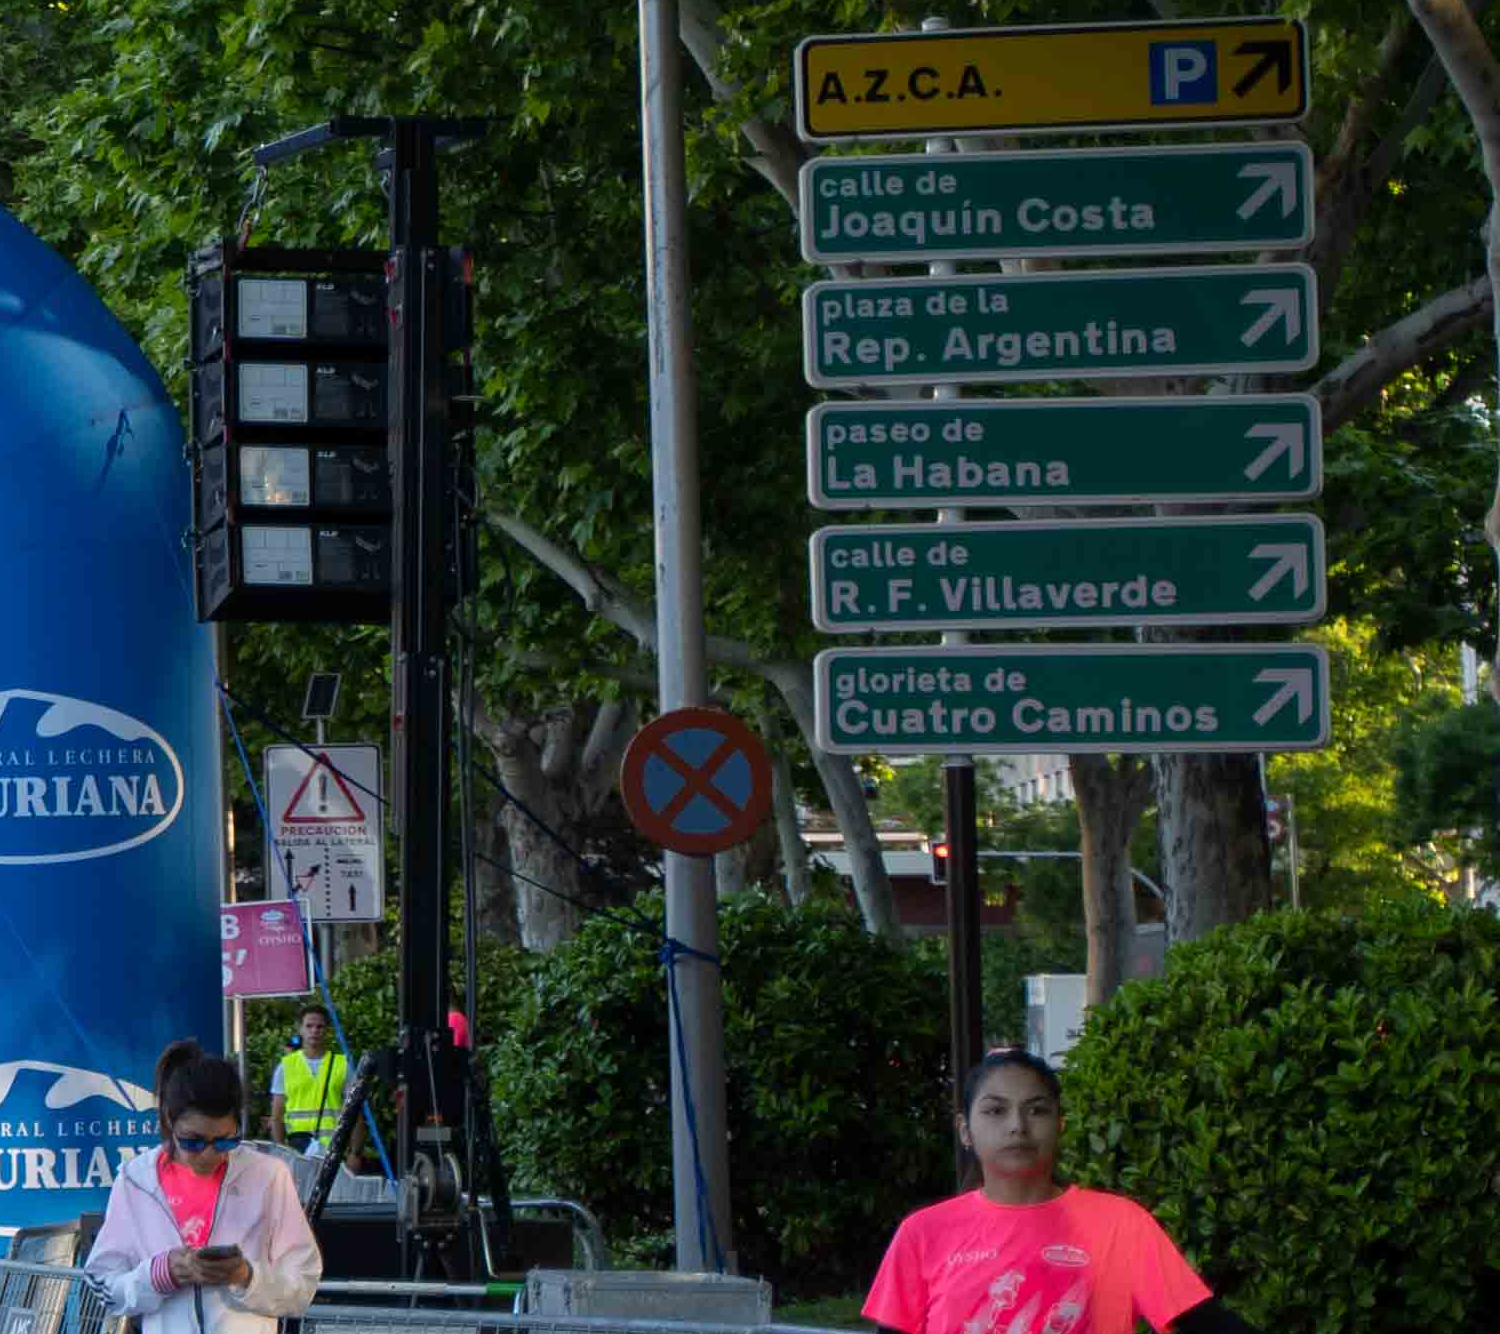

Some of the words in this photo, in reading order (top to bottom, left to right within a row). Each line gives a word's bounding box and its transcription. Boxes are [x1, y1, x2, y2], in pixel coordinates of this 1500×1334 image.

[816, 65, 1003, 106] A.Z.C.A.
[1163, 47, 1209, 99] P
[819, 170, 908, 199] calle
[916, 169, 958, 197] de
[820, 197, 1003, 243] Joaquín
[1017, 193, 1156, 233] Costa
[822, 290, 914, 323] plaza
[926, 288, 968, 317] de
[978, 287, 1009, 315] la
[824, 328, 926, 371] Rep.
[943, 320, 1177, 367] Argentina
[825, 421, 930, 449] paseo
[941, 416, 984, 442] de
[825, 457, 877, 492] La
[893, 455, 1070, 489] Habana
[830, 542, 919, 569] calle
[927, 539, 970, 567] de
[831, 581, 877, 614] R.
[890, 579, 926, 612] F.
[947, 576, 1178, 611] Villaverde
[835, 668, 974, 700] glorieta
[983, 667, 1026, 692] de
[835, 701, 996, 736] Cuatro
[1011, 696, 1219, 733] Caminos
[49, 749, 155, 765] LECHERA
